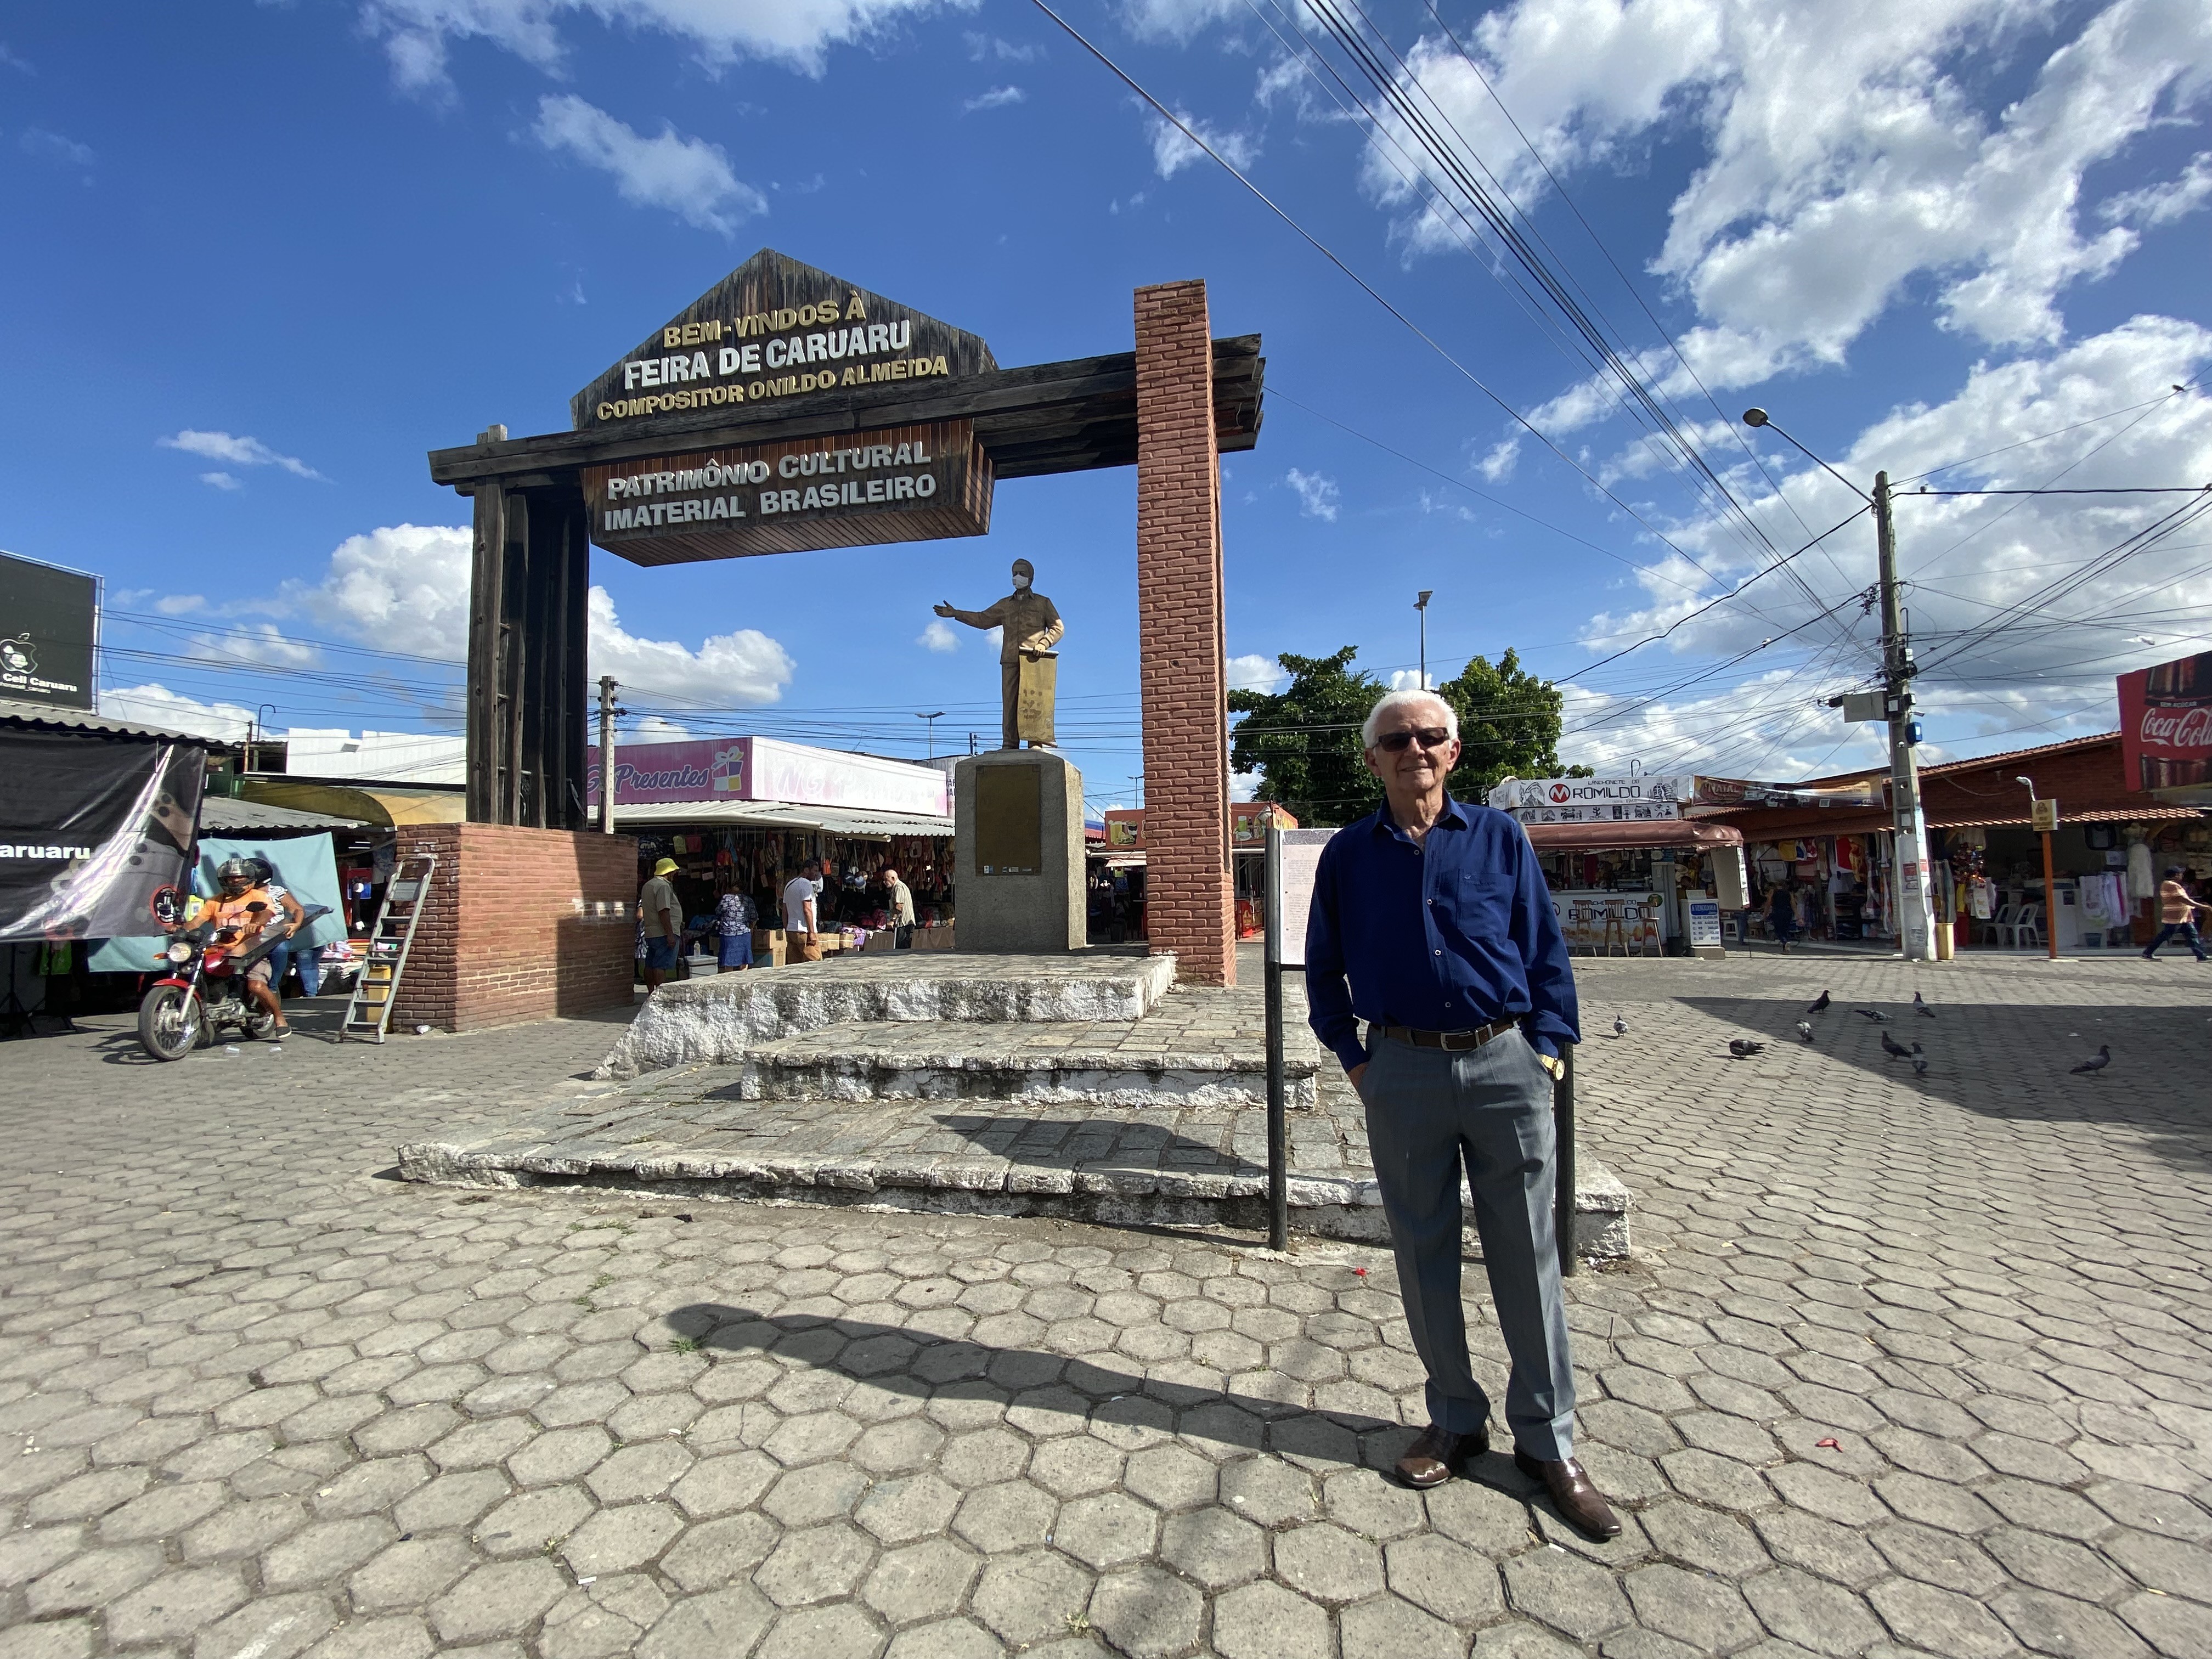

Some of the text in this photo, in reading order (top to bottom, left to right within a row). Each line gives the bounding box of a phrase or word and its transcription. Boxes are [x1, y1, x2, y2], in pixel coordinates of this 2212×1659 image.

[664, 290, 866, 349] BEM-VINDOS À
[625, 319, 911, 391] FEIRA DE CARUARU
[597, 356, 949, 420] COMPOSITOR ONILDO ALMEIDA
[607, 441, 932, 500] PATRIMÔNIO CULTURAL
[605, 473, 936, 532] IMATERIAL BRASILEIRO
[3, 673, 27, 684] Cell
[30, 678, 77, 692] Caruaru
[2140, 708, 2212, 747] Coca-Col
[614, 763, 709, 794] Presentes
[1573, 786, 1640, 799] ROMILDO
[1705, 781, 1739, 794] NATAL
[0, 845, 90, 859] aruaru
